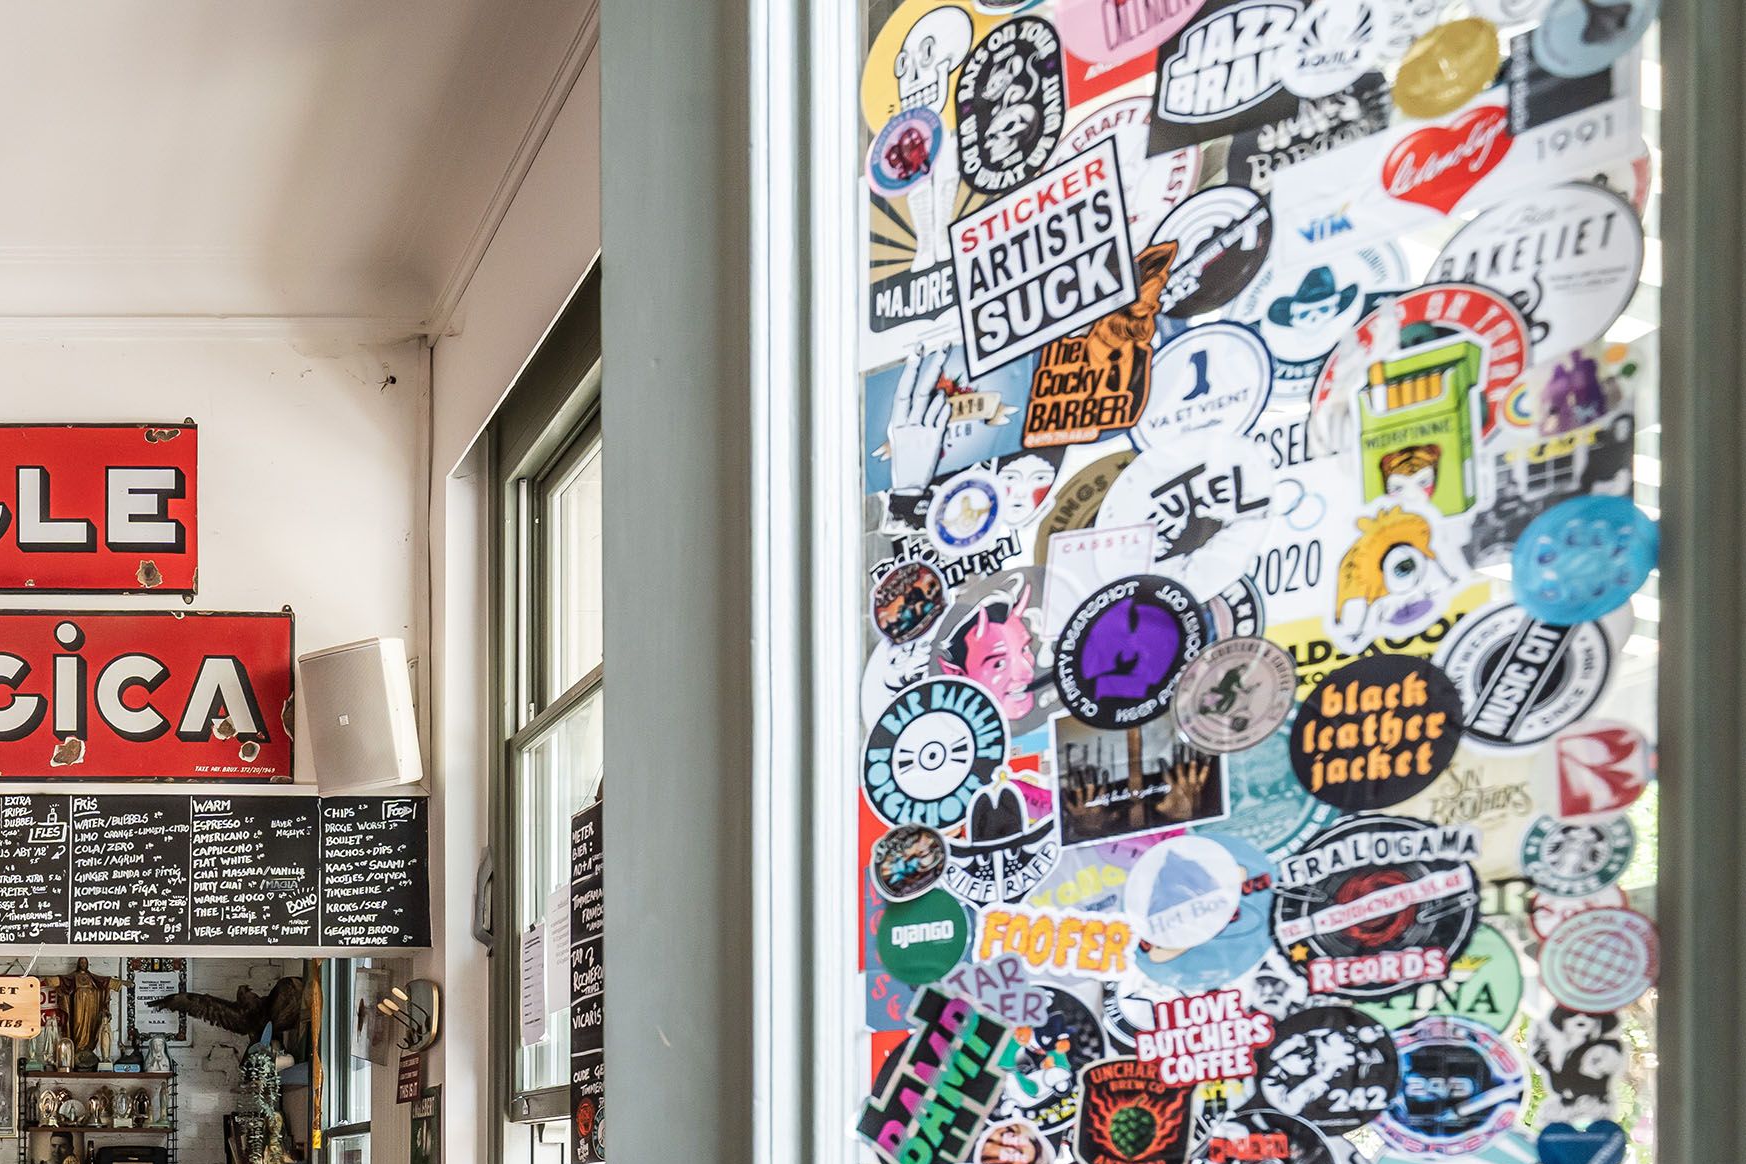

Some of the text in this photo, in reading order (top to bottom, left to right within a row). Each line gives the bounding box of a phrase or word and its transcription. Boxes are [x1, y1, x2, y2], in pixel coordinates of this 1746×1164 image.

[960, 156, 1107, 254] STICKER
[967, 190, 1114, 300] ARTISTS
[977, 242, 1122, 353] SUCK
[1027, 394, 1131, 434] BARBER
[1320, 672, 1432, 718] black
[1474, 658, 1538, 738] MUSIC
[1302, 710, 1446, 757] leather
[1310, 742, 1436, 793] jacket
[4, 796, 31, 806] EXTRA
[193, 799, 231, 813] WARM
[324, 807, 355, 818] CHIPS
[193, 820, 240, 832] ESPRESSO
[193, 831, 250, 844] AMERICANO
[1309, 947, 1447, 993] RECORDS
[1179, 990, 1242, 1027] LOVE
[1139, 1014, 1272, 1062] BUTCHERS
[1161, 1049, 1253, 1084] COFFEE
